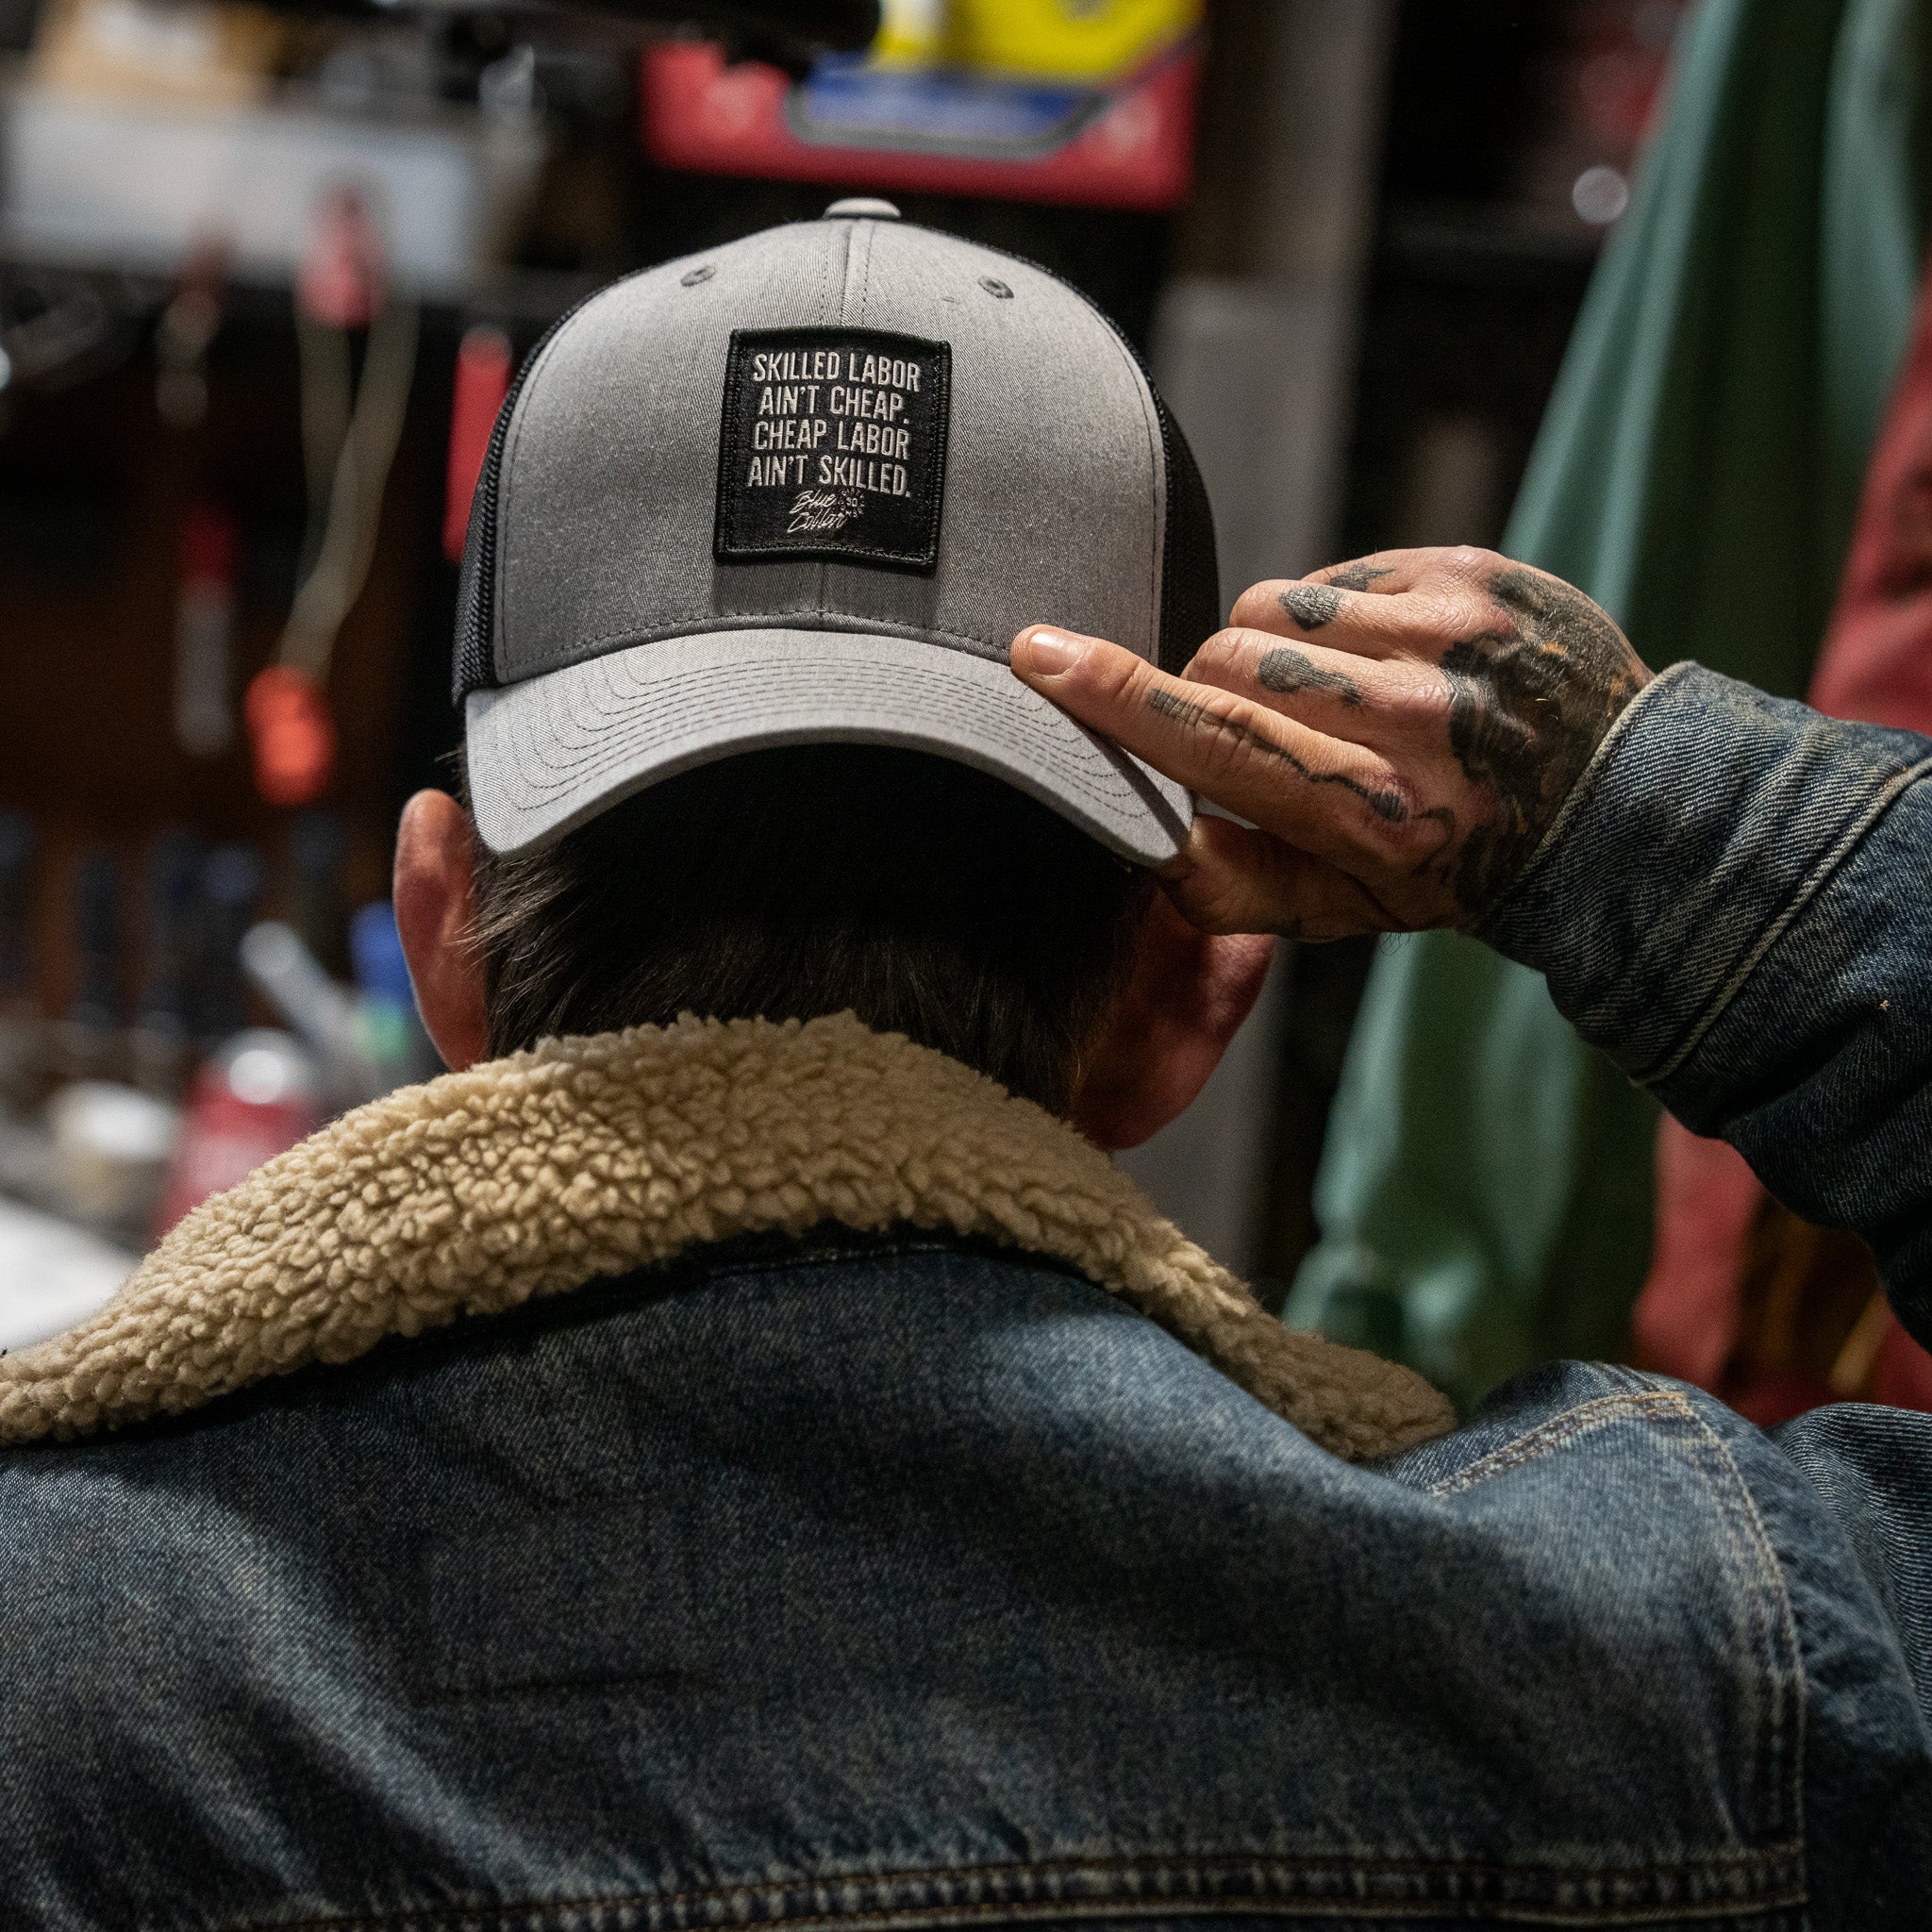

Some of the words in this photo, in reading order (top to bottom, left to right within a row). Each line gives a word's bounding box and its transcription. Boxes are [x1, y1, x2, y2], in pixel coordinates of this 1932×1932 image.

[753, 351, 841, 382] SKILLED
[849, 352, 921, 392] LABOR
[758, 385, 820, 415] AIN'T
[829, 386, 910, 425] CHEAP.
[755, 419, 826, 451] CHEAP
[837, 421, 911, 460] LABOR
[747, 455, 808, 487] AIN'T
[818, 455, 911, 498] SKILLED.
[787, 508, 848, 533] Collar
[789, 489, 837, 514] Blue
